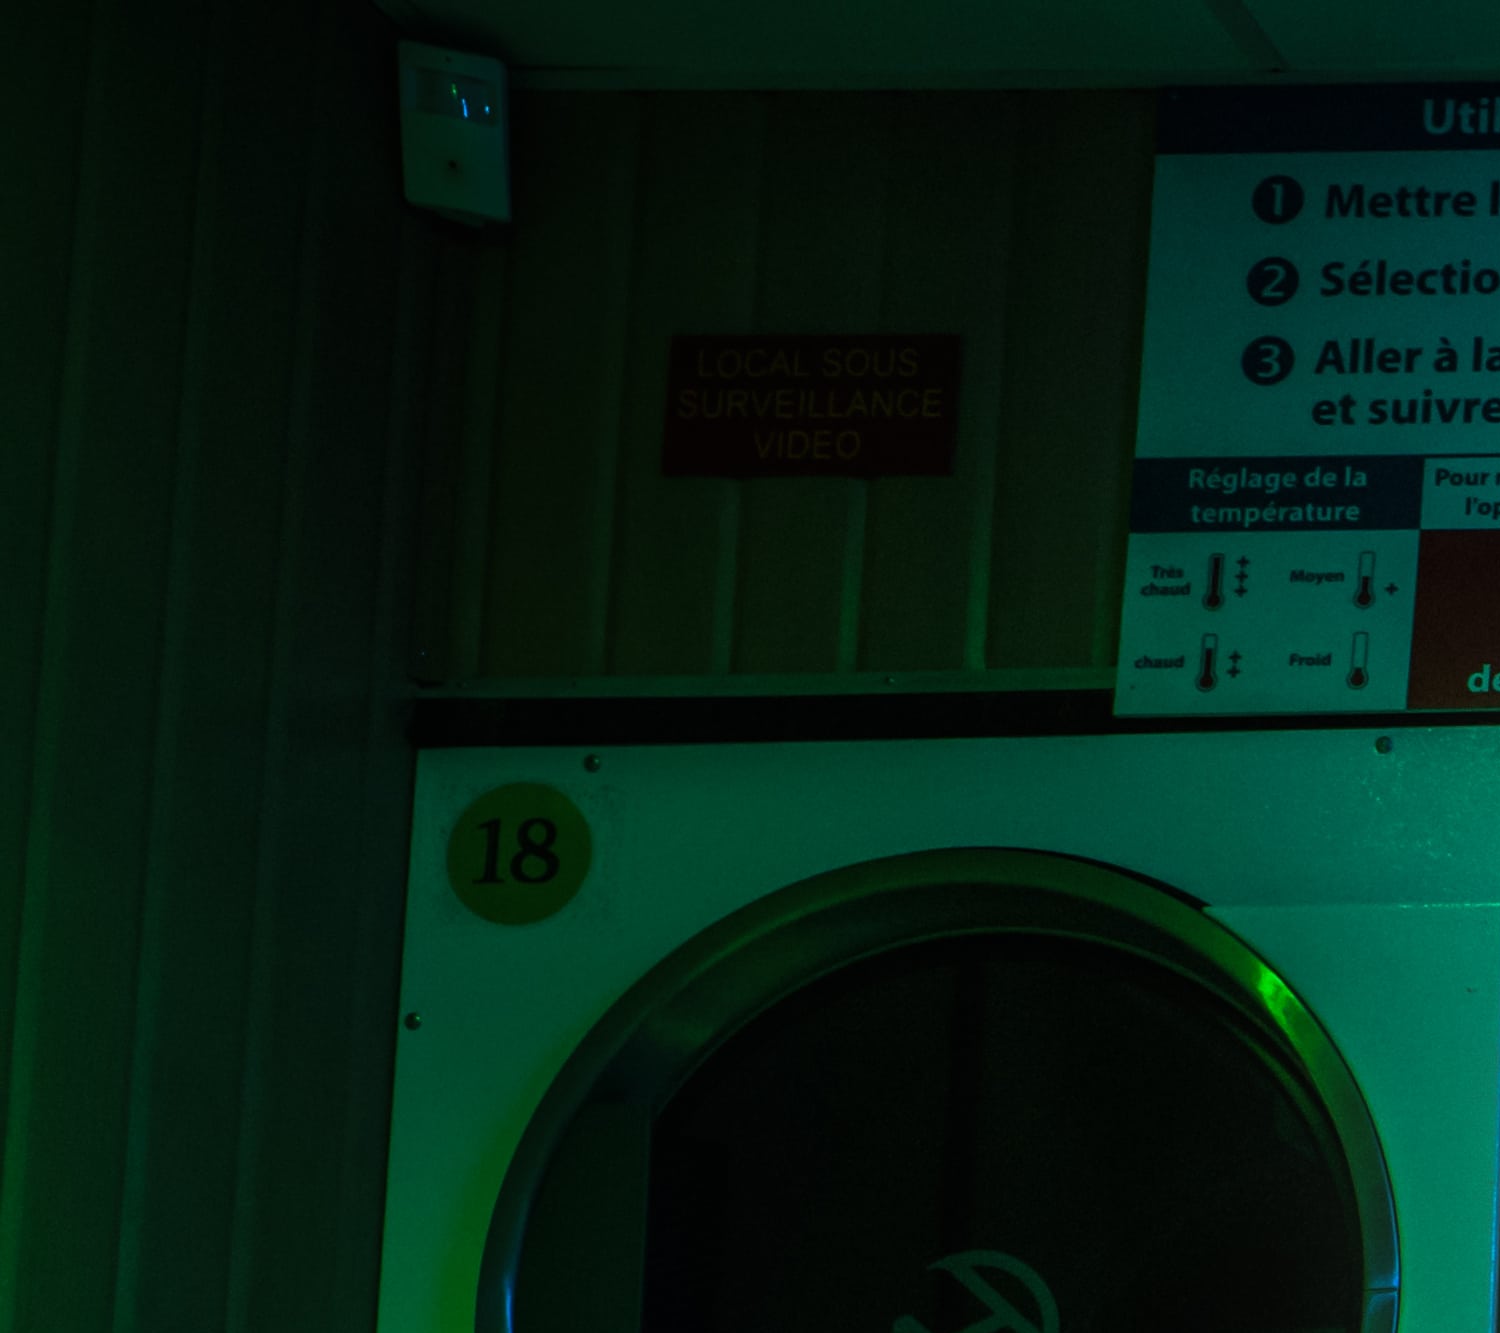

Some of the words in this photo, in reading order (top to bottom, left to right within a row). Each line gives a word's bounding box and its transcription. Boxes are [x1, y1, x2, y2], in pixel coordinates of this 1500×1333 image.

[1324, 183, 1477, 219] Mettre
[696, 348, 809, 380] LOCAL
[821, 347, 920, 378] SOUS
[1313, 337, 1422, 374] Aller
[1433, 336, 1458, 373] à
[677, 388, 944, 422] SURVEILLANCE
[1311, 393, 1356, 426] et
[752, 429, 863, 462] VIDEO
[1434, 467, 1490, 487] Pour
[471, 816, 561, 885] 18
